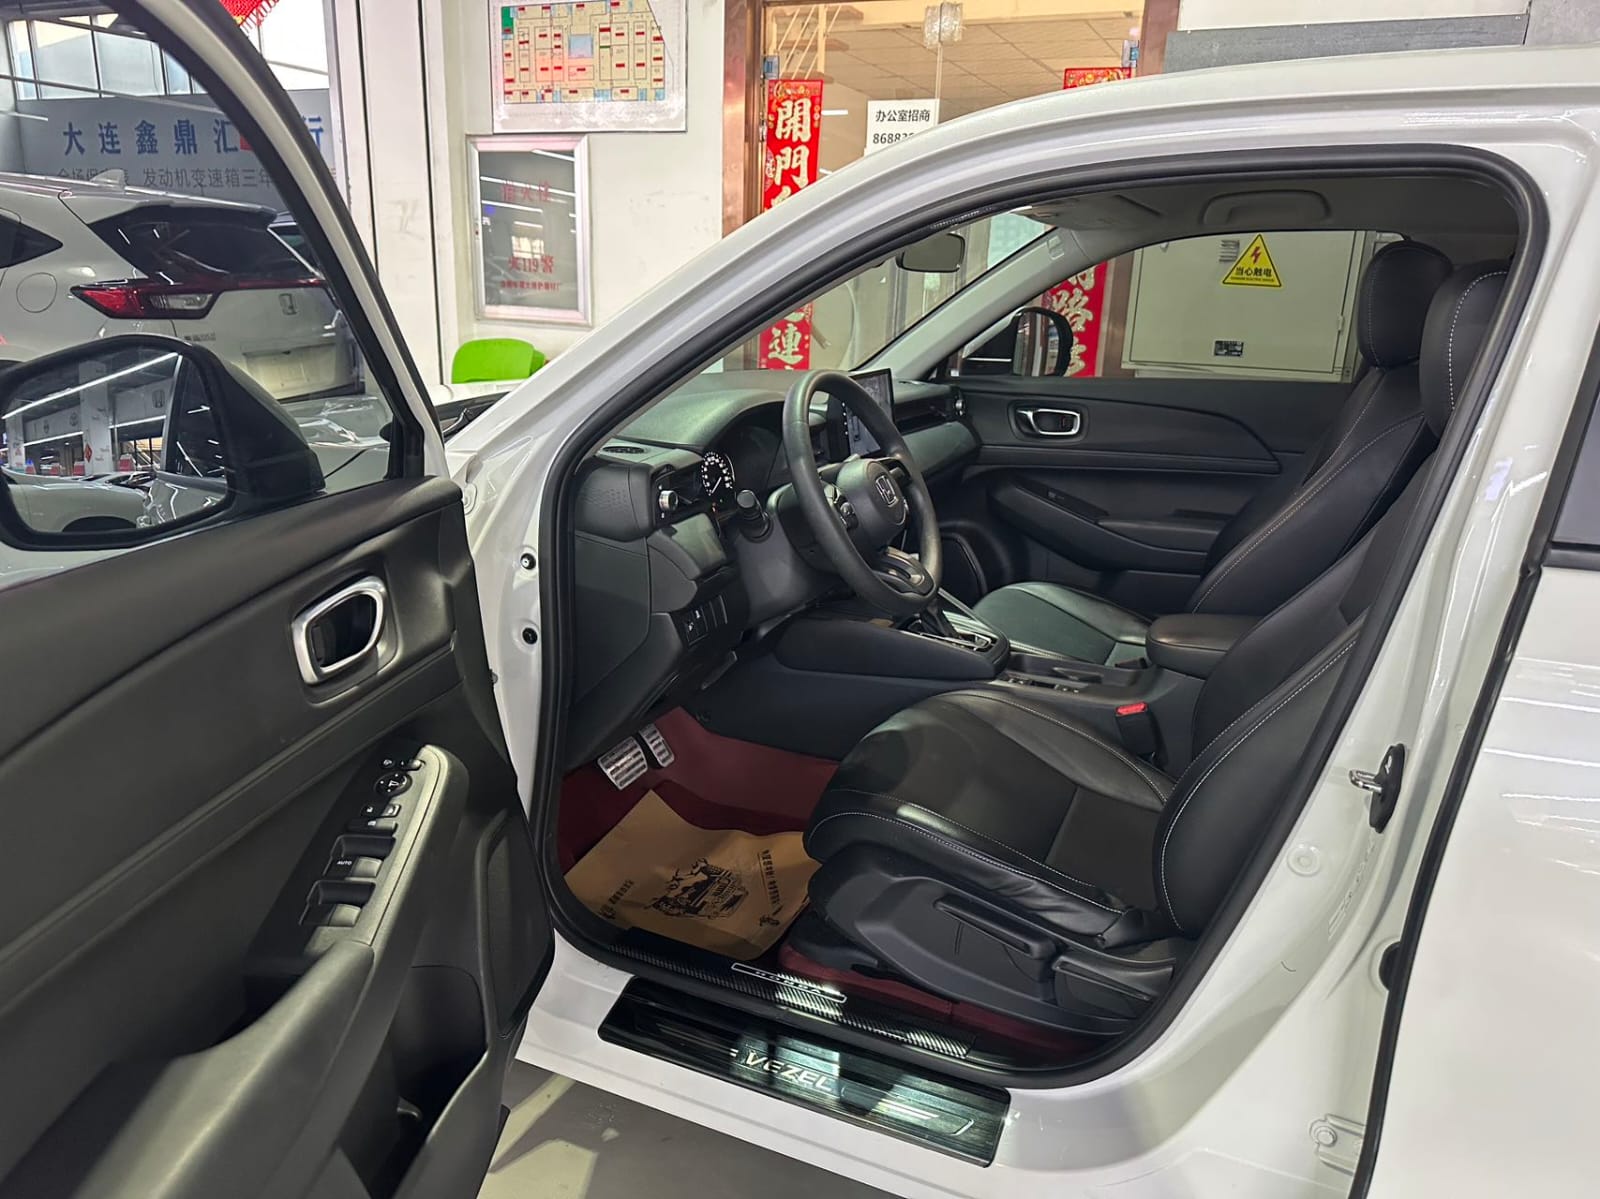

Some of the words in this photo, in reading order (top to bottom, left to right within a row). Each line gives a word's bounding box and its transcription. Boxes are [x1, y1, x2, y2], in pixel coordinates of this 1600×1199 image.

[875, 109, 931, 122] 办公室招商
[872, 132, 915, 144] 8688
[1236, 266, 1273, 277] 当心触电
[745, 1050, 833, 1093] VEZEL
